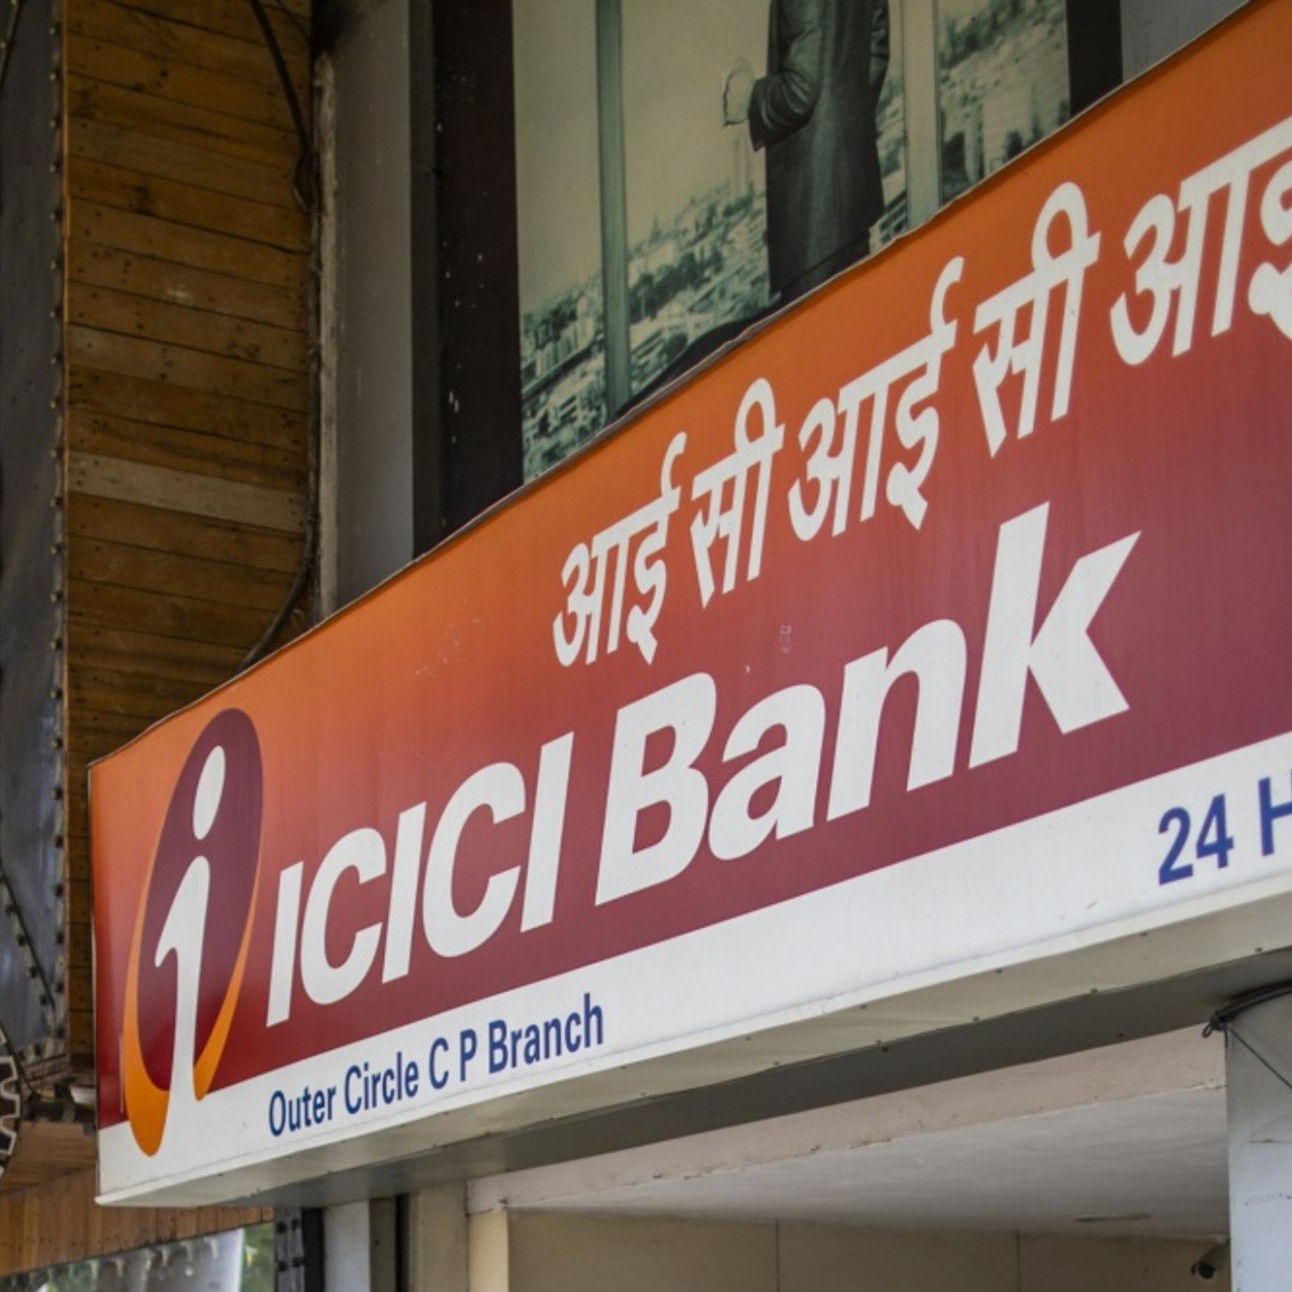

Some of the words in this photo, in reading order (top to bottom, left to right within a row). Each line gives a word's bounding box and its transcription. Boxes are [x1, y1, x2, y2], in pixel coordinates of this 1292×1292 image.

[552, 433, 687, 665] आई
[690, 378, 785, 607] सी
[788, 258, 964, 542] आई
[972, 181, 1101, 459] सी
[266, 731, 573, 1029] ICICI
[595, 502, 1142, 906] Bank
[1158, 794, 1234, 886] 24
[268, 1077, 337, 1138] Outer
[345, 1059, 418, 1117] Circle
[428, 1037, 449, 1090] C
[459, 1029, 477, 1083] P
[488, 993, 603, 1075] Branch
